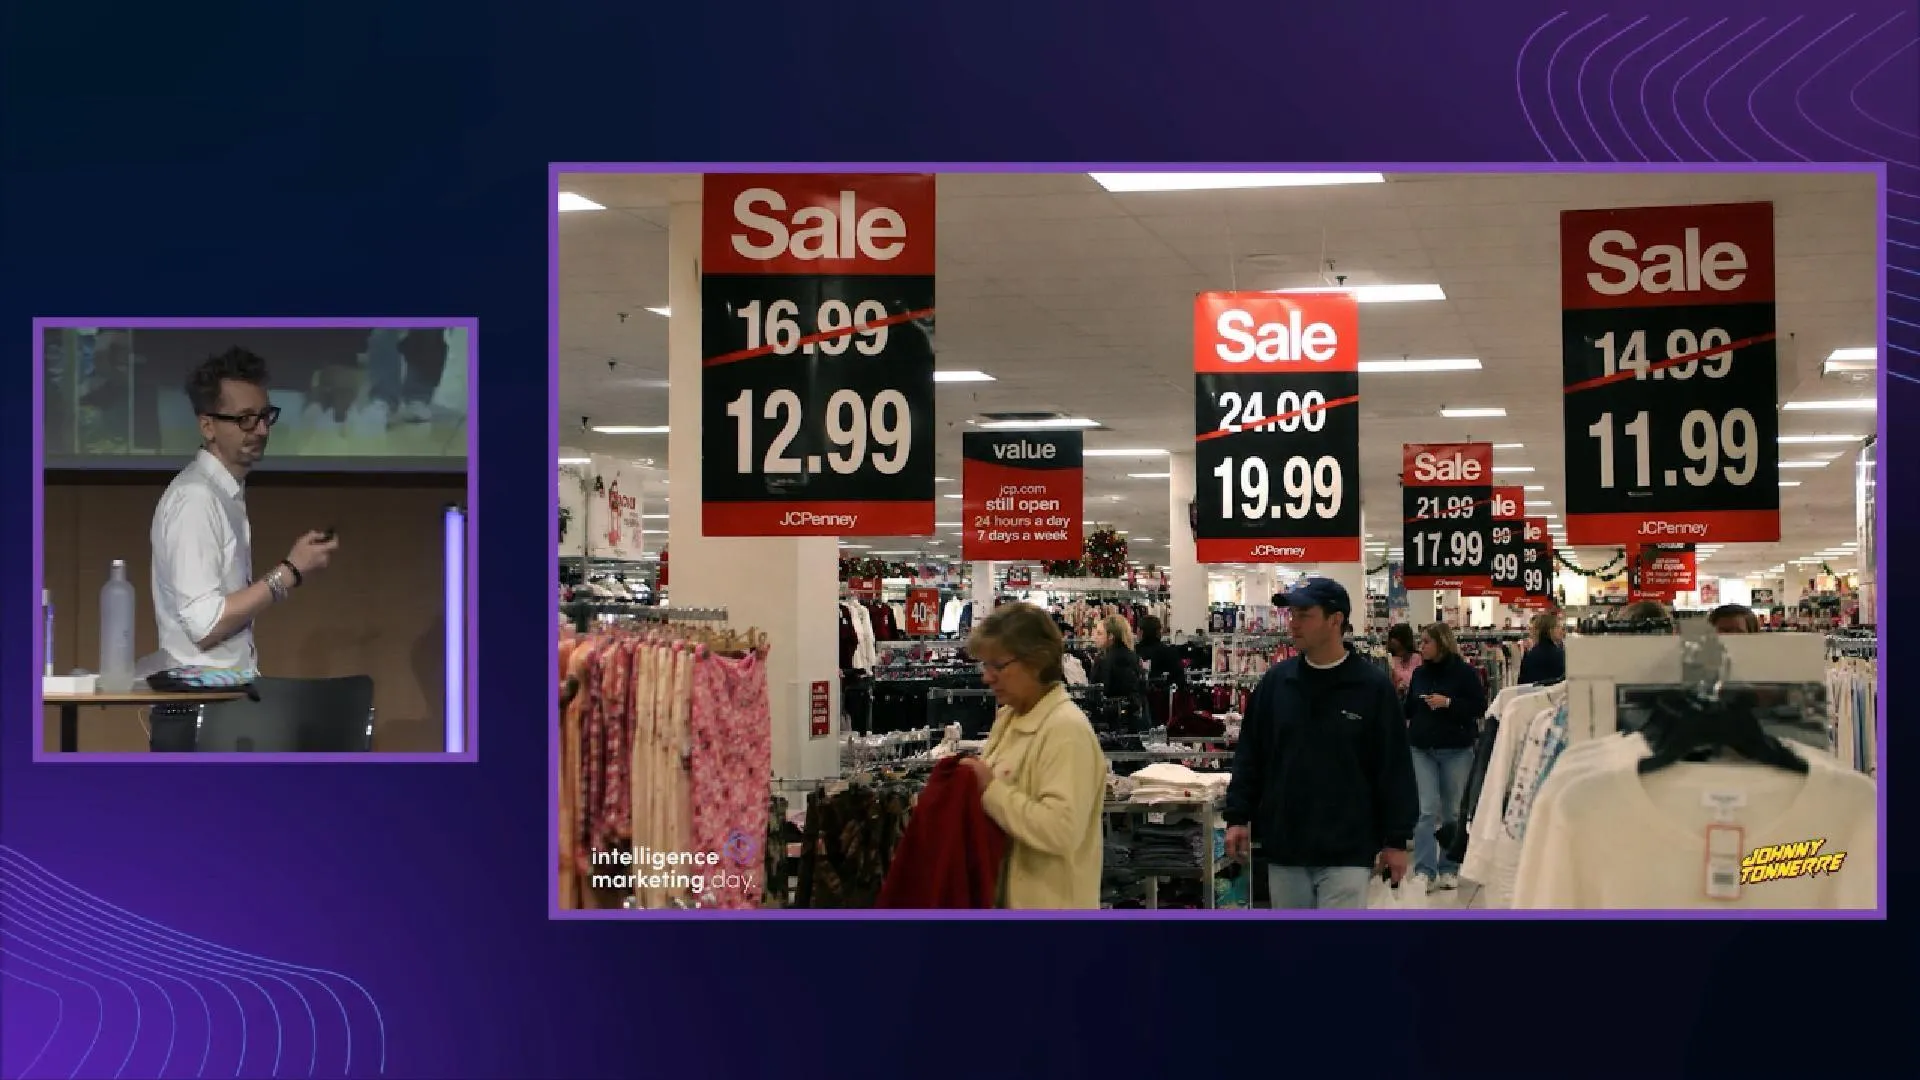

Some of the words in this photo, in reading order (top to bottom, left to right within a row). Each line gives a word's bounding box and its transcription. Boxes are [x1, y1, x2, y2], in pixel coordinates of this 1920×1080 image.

[732, 188, 906, 260] Sale
[1587, 228, 1746, 295] Sale
[737, 300, 889, 356] 16.99
[1215, 310, 1338, 363] Sale
[1594, 327, 1734, 381] 14.99
[1219, 391, 1326, 433] 24.00
[727, 389, 912, 474] 12.99
[1589, 408, 1759, 488] 11.99
[993, 440, 1056, 459] value
[1414, 452, 1482, 481] Sale
[999, 485, 1046, 497] jcp.com
[1214, 455, 1342, 519] 19.99
[780, 512, 857, 528] JCPenney
[975, 516, 990, 527] 24
[994, 515, 1031, 527] hours
[1034, 518, 1043, 526] a
[1046, 515, 1071, 528] day
[986, 497, 1014, 510] still
[1018, 500, 1060, 513] open
[1417, 497, 1474, 519] 21.99
[978, 530, 986, 541] 7
[989, 530, 1020, 543] days
[1022, 532, 1030, 540] a
[1034, 530, 1068, 540] week
[1637, 520, 1708, 536] JCPenney
[1251, 545, 1306, 558] JCPenney
[1412, 530, 1483, 567] 17.99
